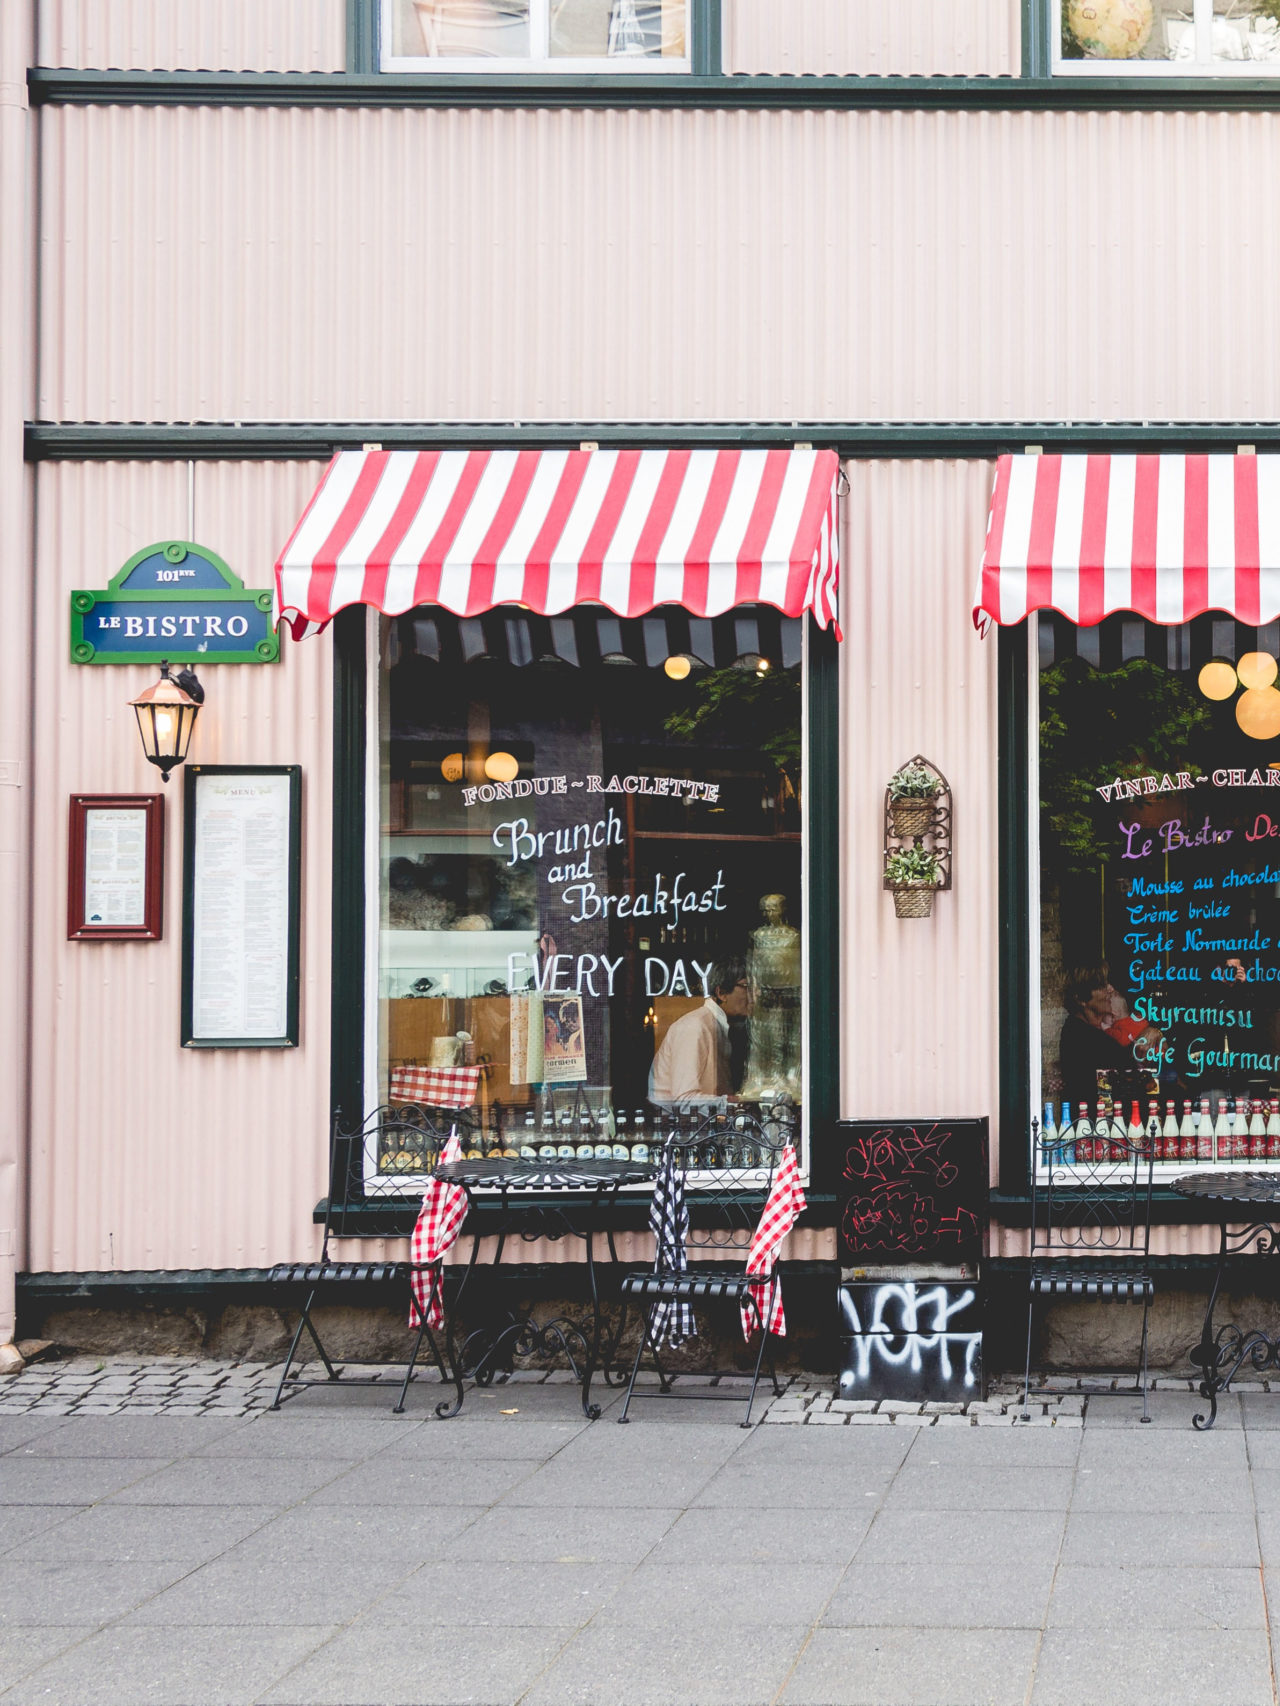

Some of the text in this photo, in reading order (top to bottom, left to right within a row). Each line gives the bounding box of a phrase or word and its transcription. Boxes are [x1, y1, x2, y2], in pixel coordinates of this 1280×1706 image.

[98, 615, 249, 638] LE BISTRO
[461, 775, 568, 807] FONDUE
[586, 774, 720, 803] RACLETTE
[1096, 771, 1195, 803] VÍNBAR
[492, 807, 625, 867] Brunch
[1118, 820, 1153, 860] Le
[1158, 816, 1235, 854] Bistro
[547, 850, 593, 884] and
[561, 868, 727, 931] Breakfast
[1127, 877, 1184, 898] Mousse
[1193, 876, 1214, 890] au
[1126, 903, 1180, 926] Crème
[1182, 927, 1271, 953] Normande
[506, 951, 713, 999] EVERY DAY
[1127, 958, 1203, 993] Gateau
[1210, 965, 1237, 983] au
[1133, 1035, 1177, 1077] Café
